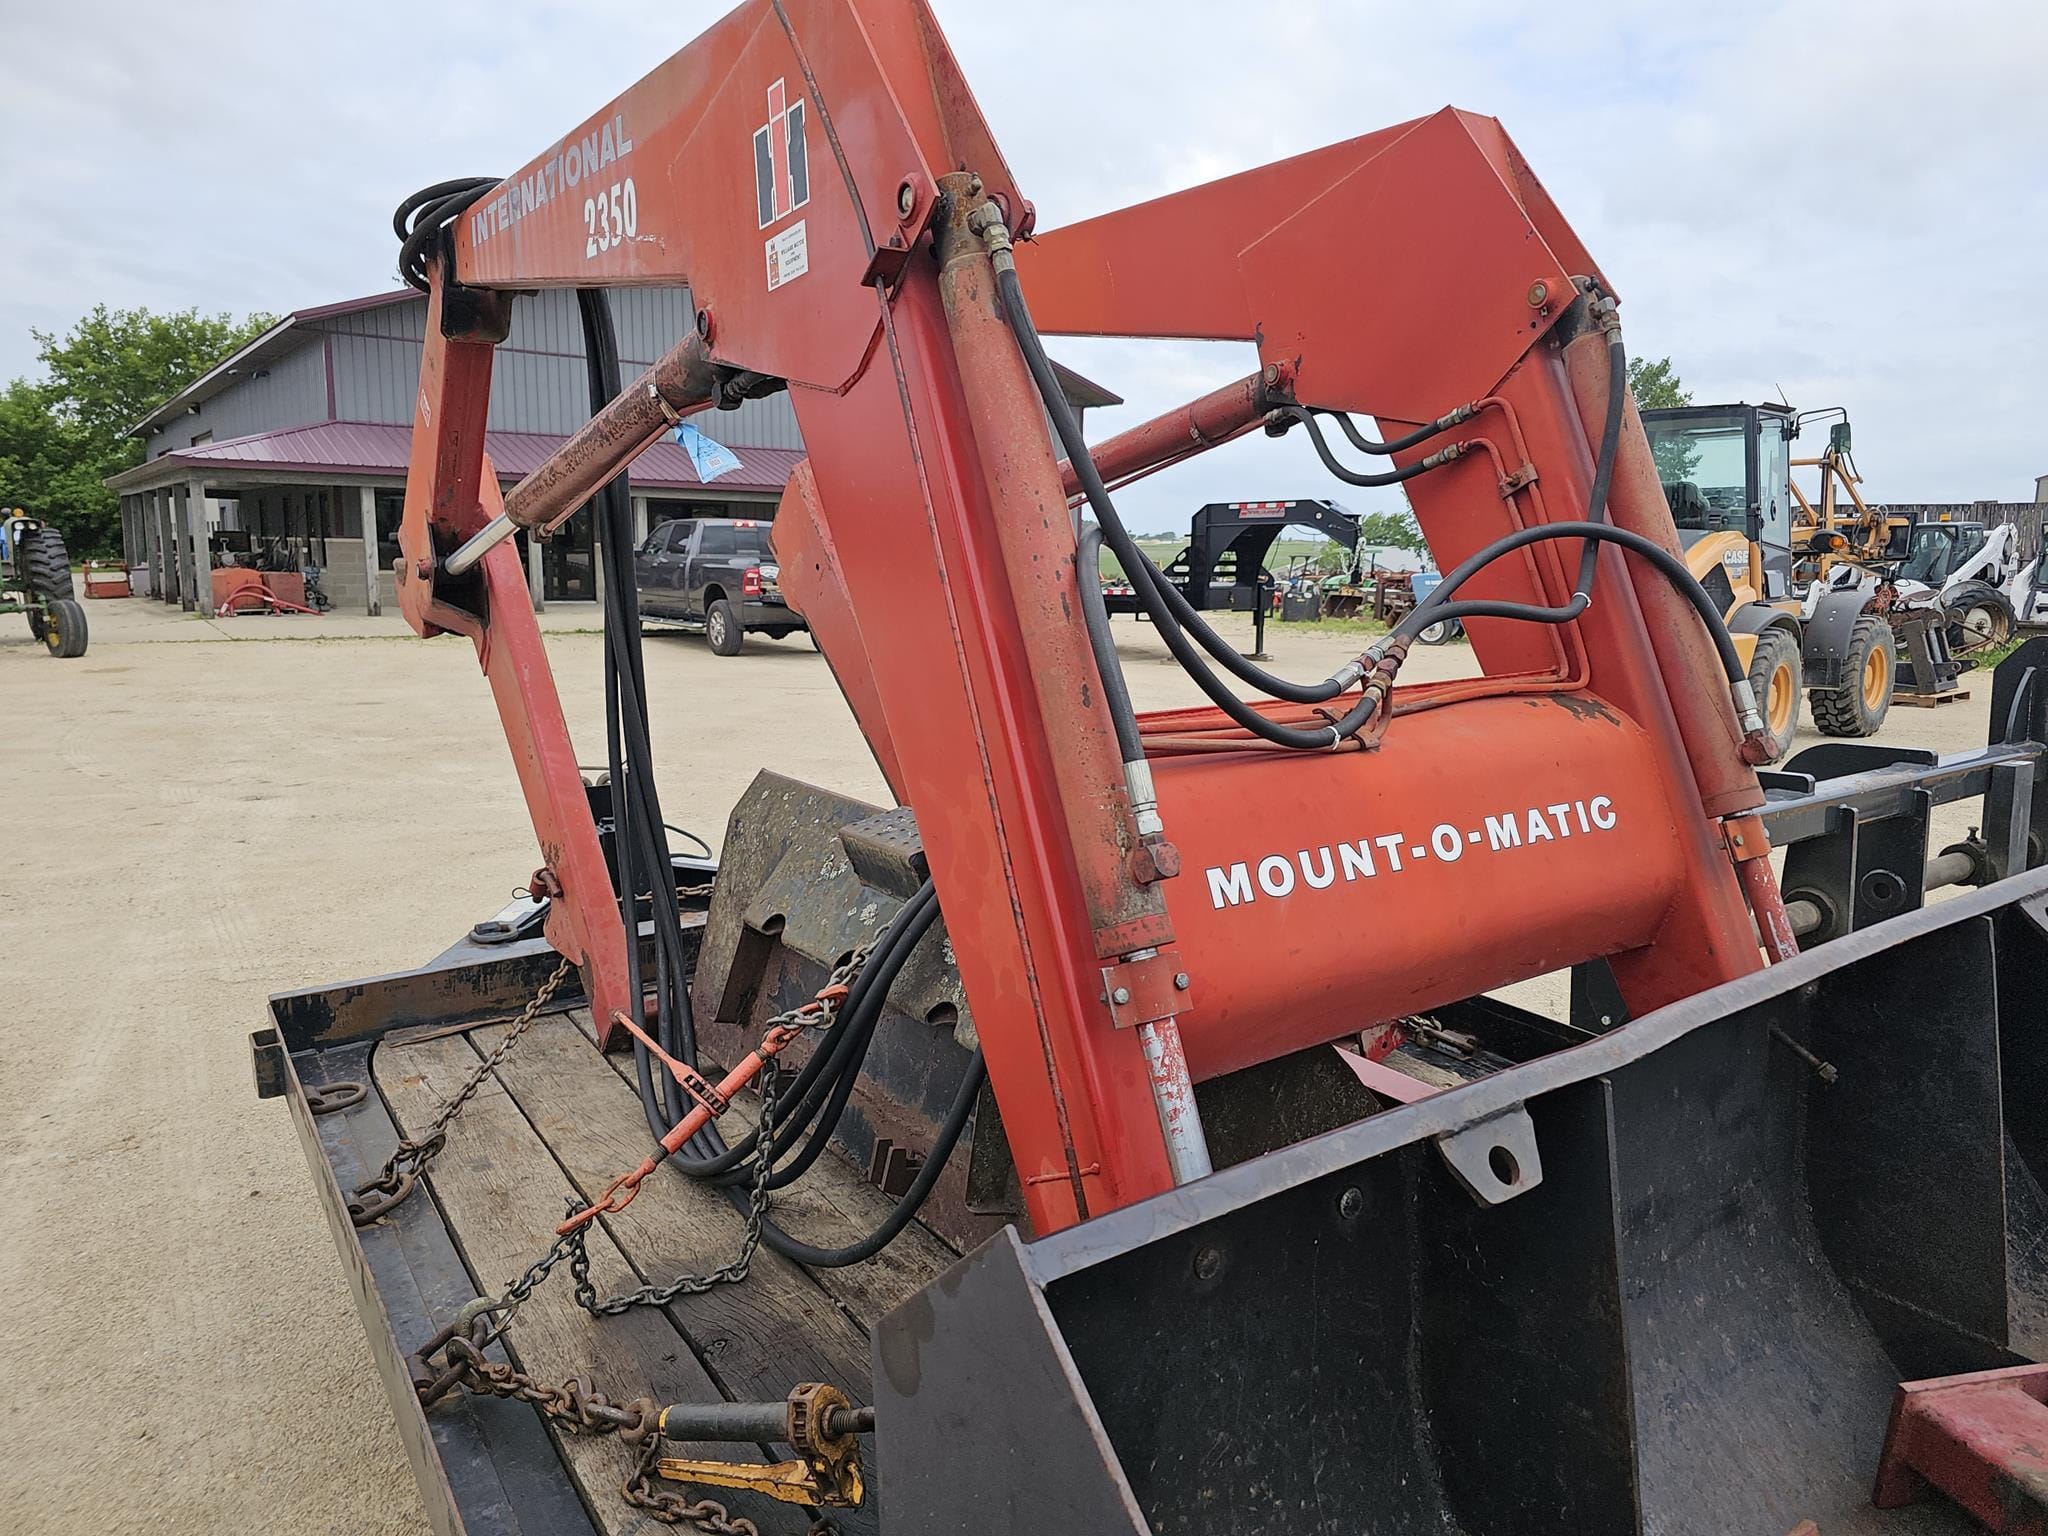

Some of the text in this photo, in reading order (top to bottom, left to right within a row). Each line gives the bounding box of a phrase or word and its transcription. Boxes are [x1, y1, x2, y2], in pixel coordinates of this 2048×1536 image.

[471, 114, 633, 248] INTERNATIONAL
[584, 177, 637, 260] 2350
[1723, 550, 1749, 565] CASE
[1205, 795, 1617, 910] MOUNT-O-MATIC
